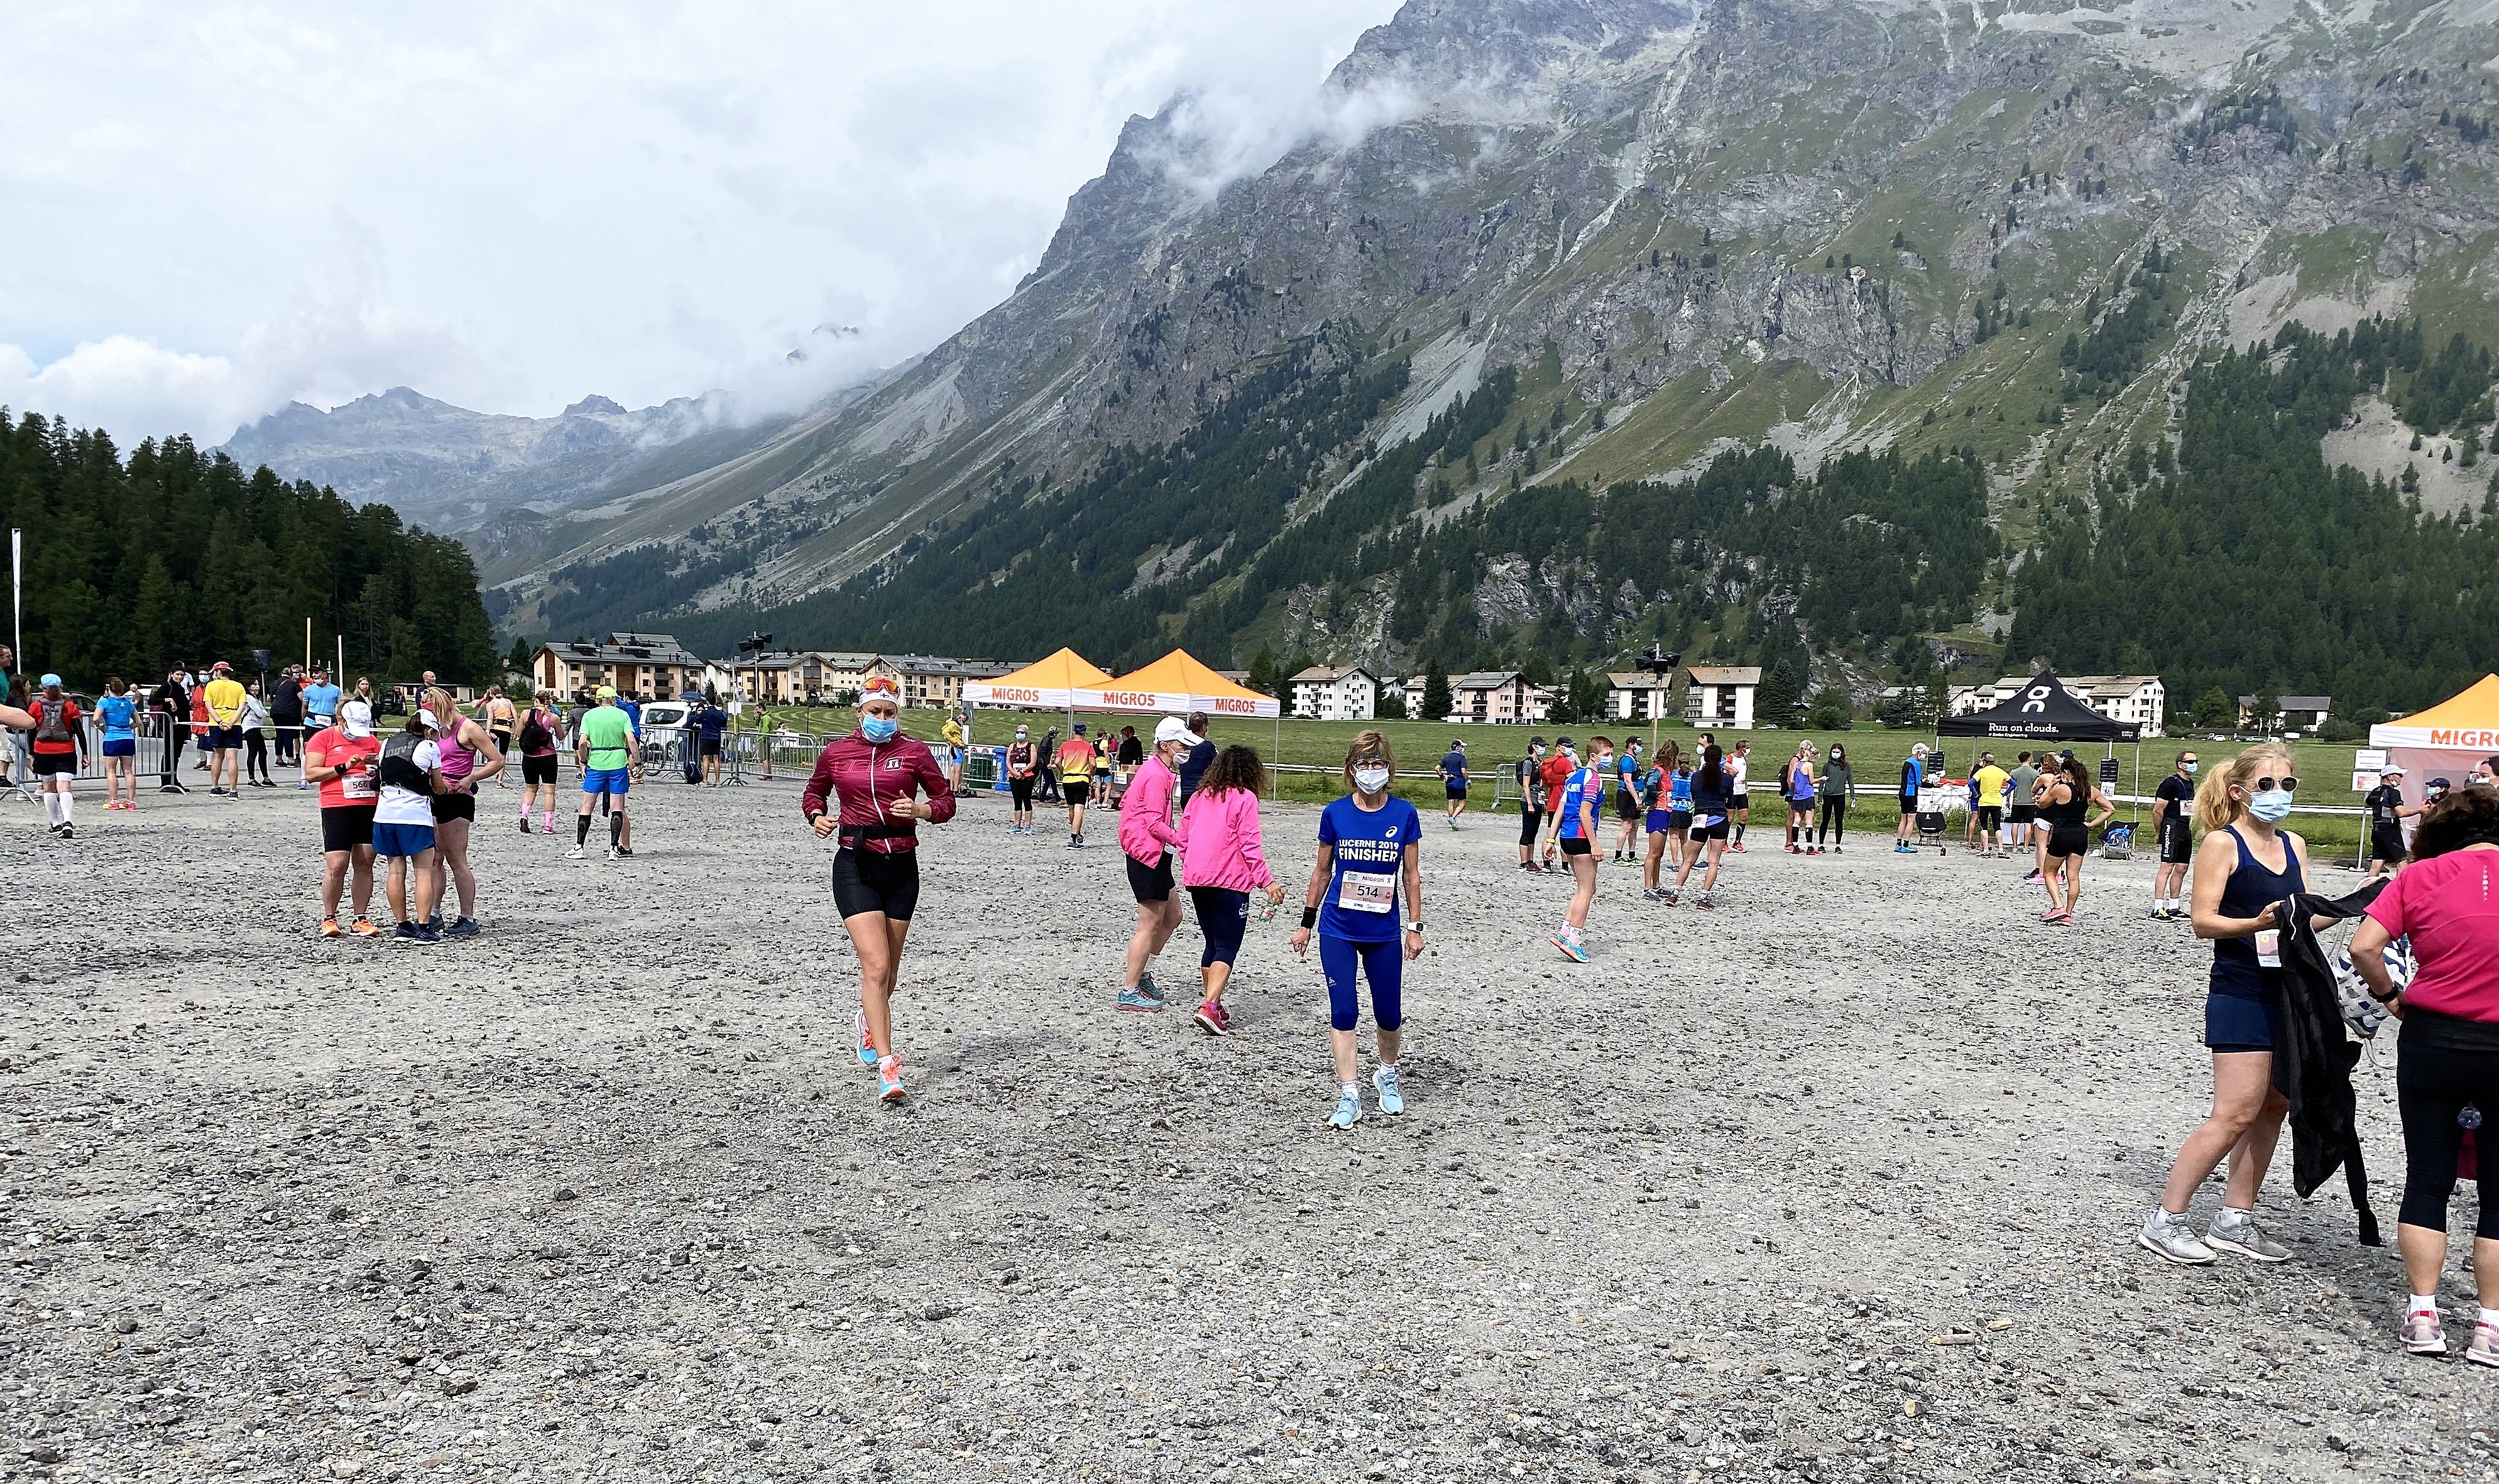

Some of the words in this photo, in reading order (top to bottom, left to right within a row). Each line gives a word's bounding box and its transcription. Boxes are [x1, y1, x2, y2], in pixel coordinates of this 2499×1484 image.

[992, 687, 1039, 702] MIGROS
[1103, 692, 1155, 707] MIGROS
[1215, 698, 1255, 713] MIGROS
[1988, 723, 2008, 731] Run
[2025, 723, 2059, 733] clouds.
[353, 781, 368, 789] 566
[1339, 839, 1376, 848] LUCERNE
[1379, 841, 1399, 849] 2019
[1339, 848, 1398, 863] FINISHER
[1357, 885, 1379, 898] 514
